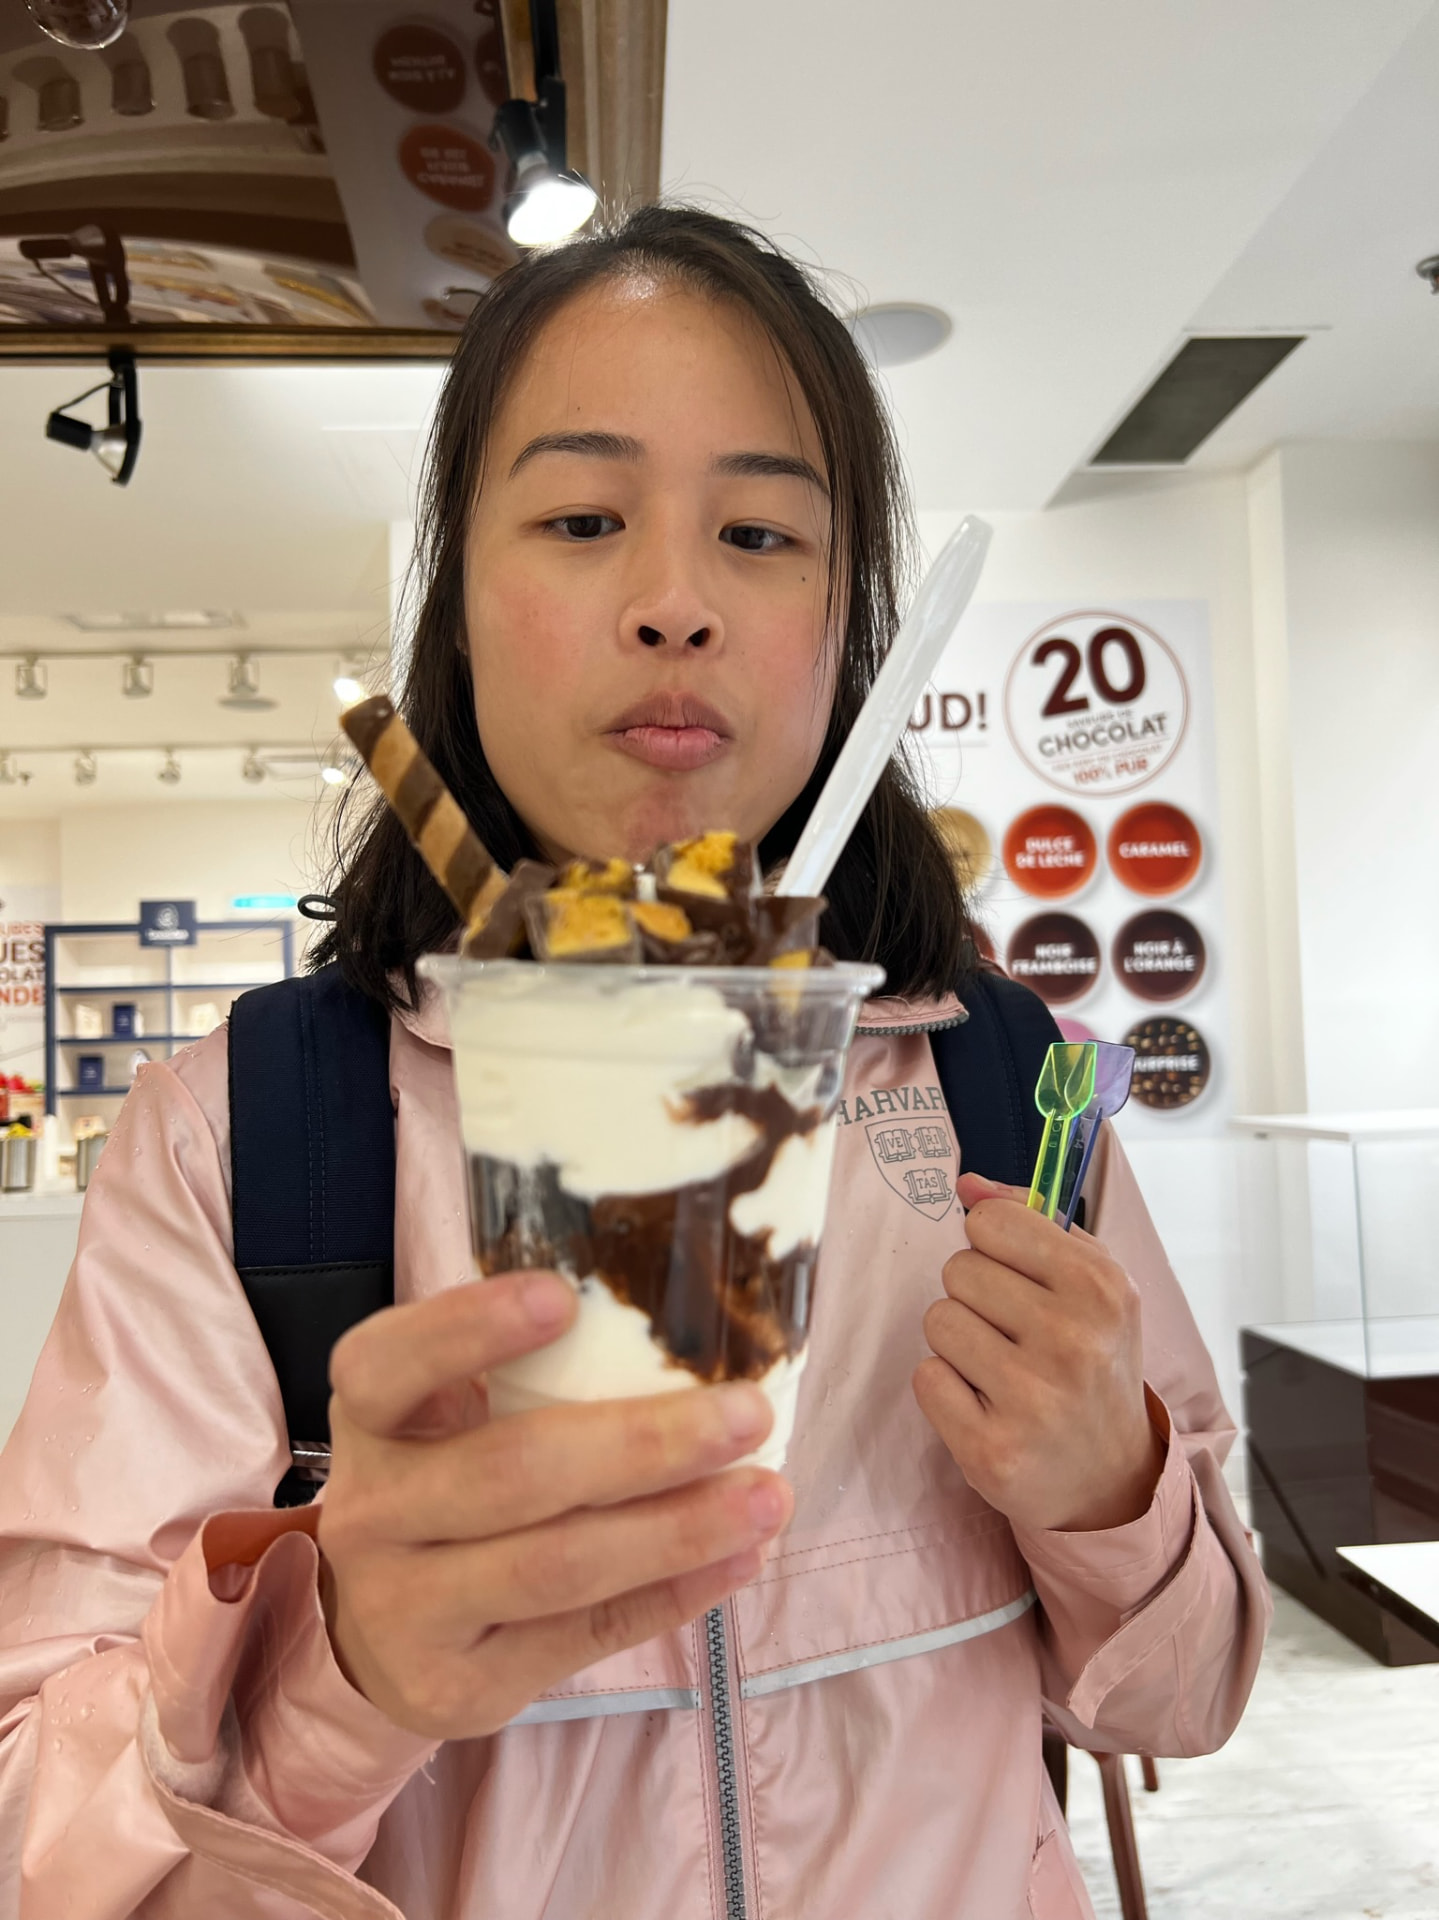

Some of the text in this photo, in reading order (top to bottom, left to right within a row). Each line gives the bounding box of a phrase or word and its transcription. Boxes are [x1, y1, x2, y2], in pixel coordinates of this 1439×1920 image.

[1031, 626, 1146, 720] 20
[1038, 713, 1168, 758] CHOCOLAT
[1025, 836, 1075, 852] DULCE
[1119, 841, 1190, 860] CARAMEL
[1016, 851, 1086, 868] DE LECHE
[1035, 943, 1073, 959] NOIR
[1134, 942, 1171, 957] NOIR
[1012, 959, 1097, 976] FRAMBOISE
[1124, 955, 1195, 974] L'ORANGE
[1133, 1054, 1200, 1072] URPRISE
[887, 1134, 939, 1149] VE RI
[916, 1176, 938, 1190] TAS
